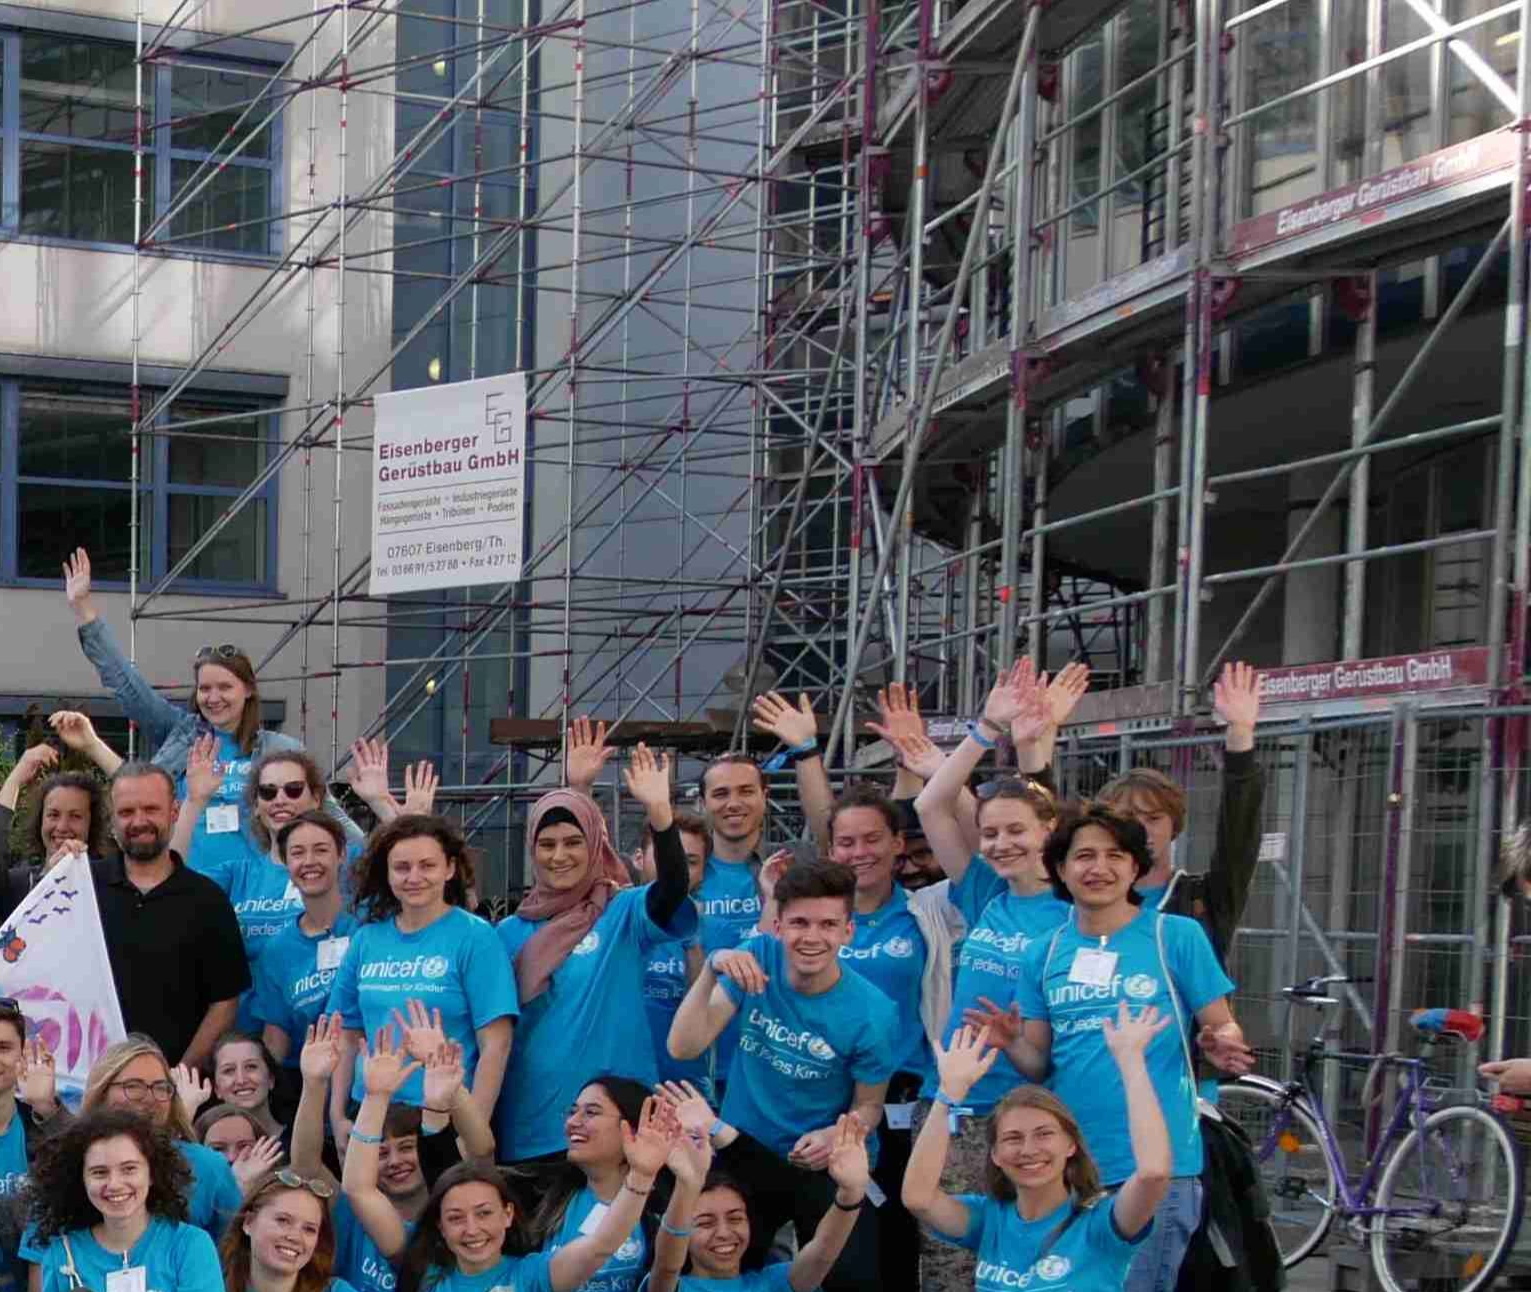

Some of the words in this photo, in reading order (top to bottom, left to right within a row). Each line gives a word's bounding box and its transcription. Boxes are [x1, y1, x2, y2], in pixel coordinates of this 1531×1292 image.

[379, 434, 479, 461] Eisenberger
[378, 457, 462, 483] Gerüstbau
[468, 448, 520, 471] GmbH
[387, 543, 422, 559] 07607
[469, 555, 485, 569] Fax
[1258, 670, 1332, 697] Eisenberger
[1334, 662, 1404, 690] Gerüstbau
[1407, 654, 1451, 682] GmbH
[837, 940, 883, 960] cef
[360, 956, 423, 979] unicef
[1048, 974, 1123, 1005] unicef
[975, 1259, 1031, 1288] unice
